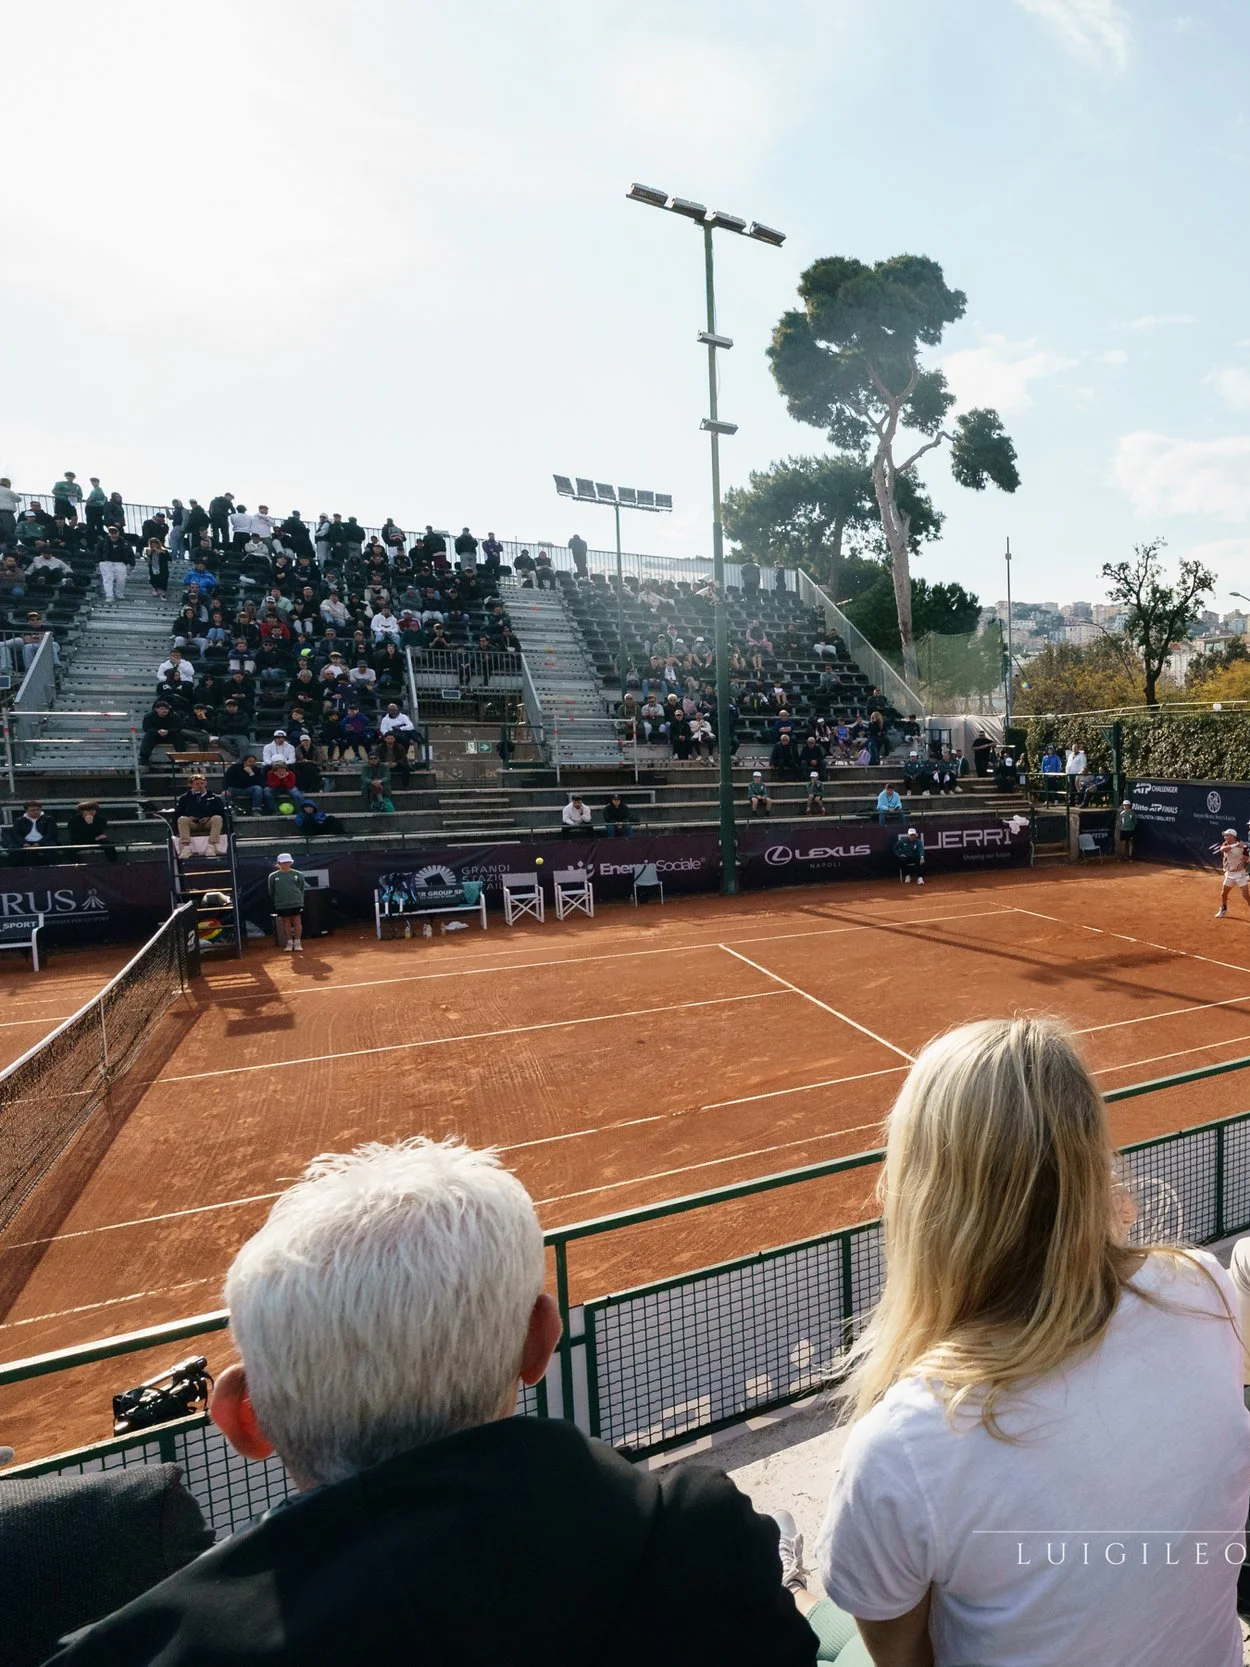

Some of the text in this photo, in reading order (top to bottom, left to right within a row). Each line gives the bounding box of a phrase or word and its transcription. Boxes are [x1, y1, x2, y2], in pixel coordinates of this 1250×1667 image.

[1133, 783, 1178, 794] ATP CHALLENGER
[794, 844, 872, 860] LEXUS
[461, 864, 511, 876] GRANDI
[600, 858, 702, 876] EnerSociale
[809, 861, 841, 869] NAPOLI
[3, 920, 37, 930] SPORT
